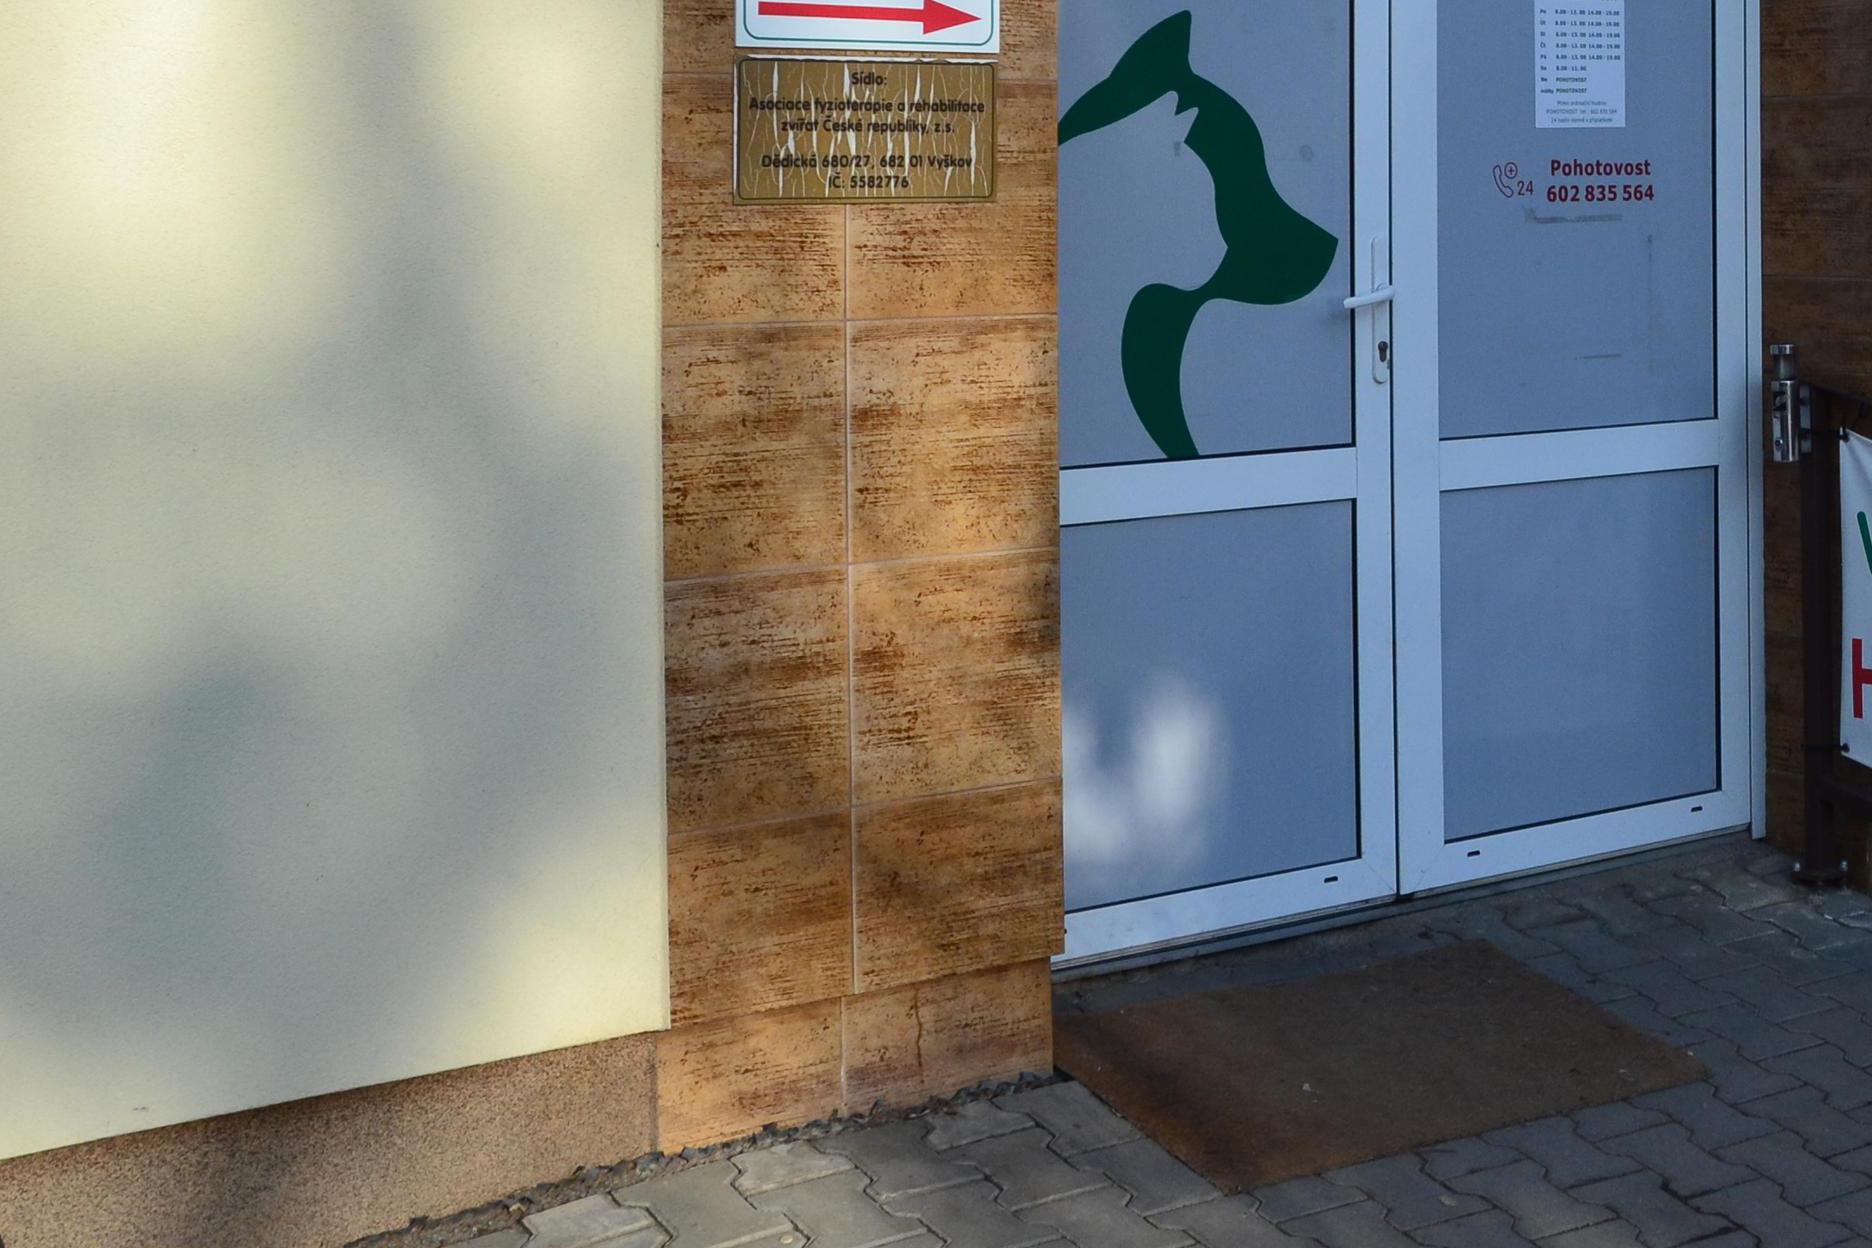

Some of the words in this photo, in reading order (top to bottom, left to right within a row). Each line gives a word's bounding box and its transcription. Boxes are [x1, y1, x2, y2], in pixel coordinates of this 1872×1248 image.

[851, 71, 888, 86] Sídlo:
[749, 97, 811, 111] Asociace
[814, 96, 893, 114] fyzioterapie
[897, 102, 906, 112] a
[910, 99, 985, 112] rehabilitace
[822, 115, 863, 132] České
[867, 119, 930, 135] republiky,
[934, 123, 955, 133] z.s.
[761, 154, 818, 168] Dědická
[822, 154, 875, 170] 680/27,
[880, 154, 905, 168] 682
[909, 155, 923, 168] 01
[927, 154, 973, 170] Vyškov
[1550, 158, 1652, 177] Pohotovost
[828, 172, 846, 189] IČ:
[850, 175, 910, 189] 5582776
[1516, 180, 1534, 196] 24
[1546, 185, 1580, 203] 602
[1584, 184, 1618, 202] 835
[1622, 184, 1655, 201] 564
